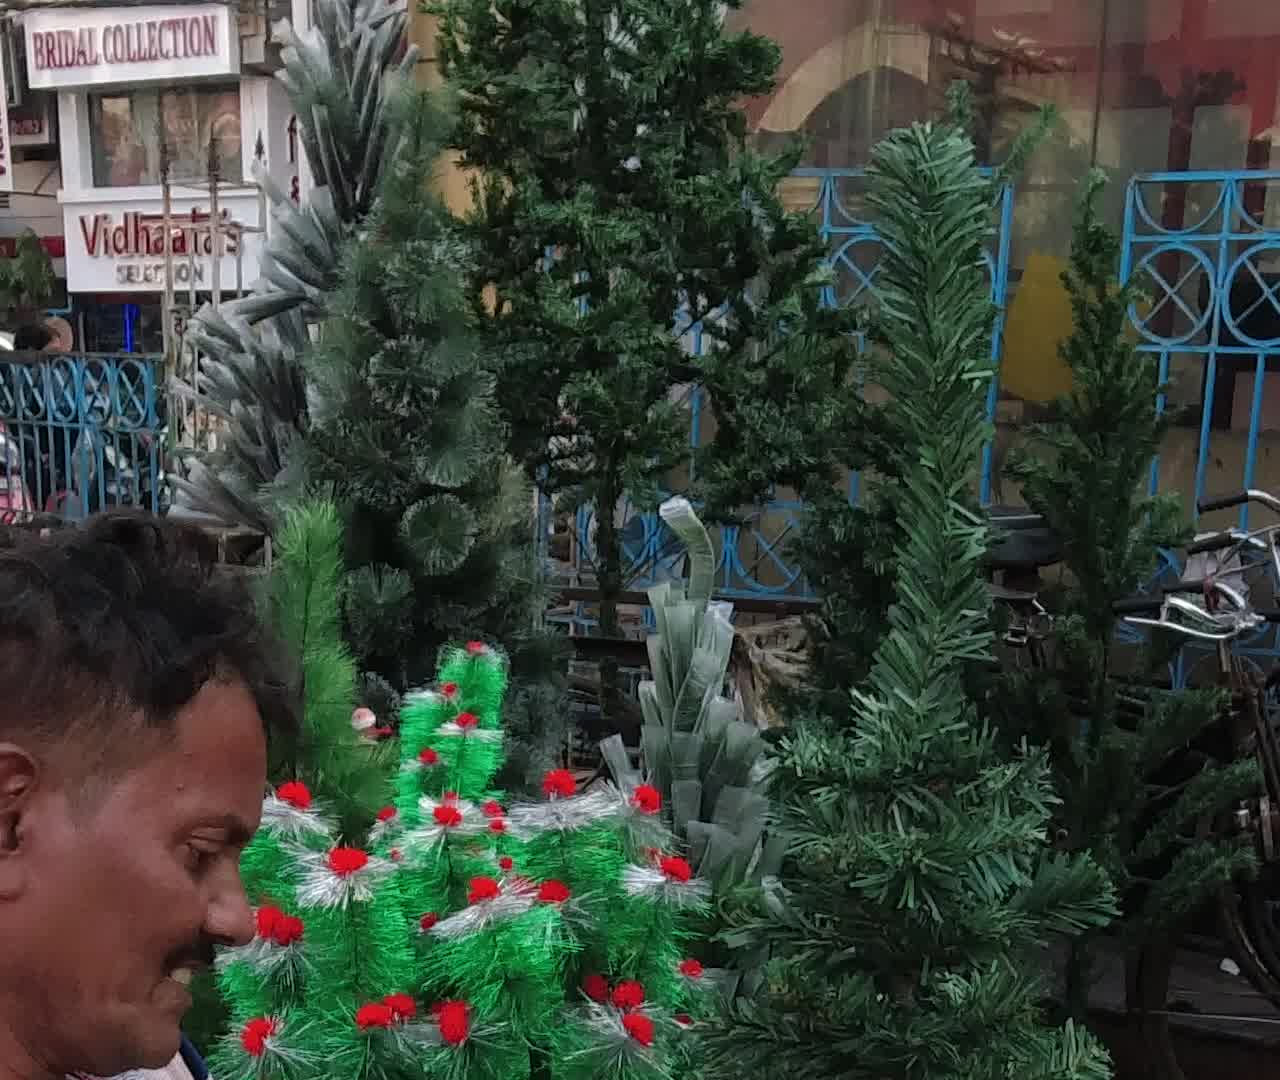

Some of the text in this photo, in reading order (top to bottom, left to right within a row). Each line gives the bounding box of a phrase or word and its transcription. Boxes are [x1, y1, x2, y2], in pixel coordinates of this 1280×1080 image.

[32, 15, 219, 71] BRIDAL COLLECTION
[115, 263, 205, 285] SELECTON
